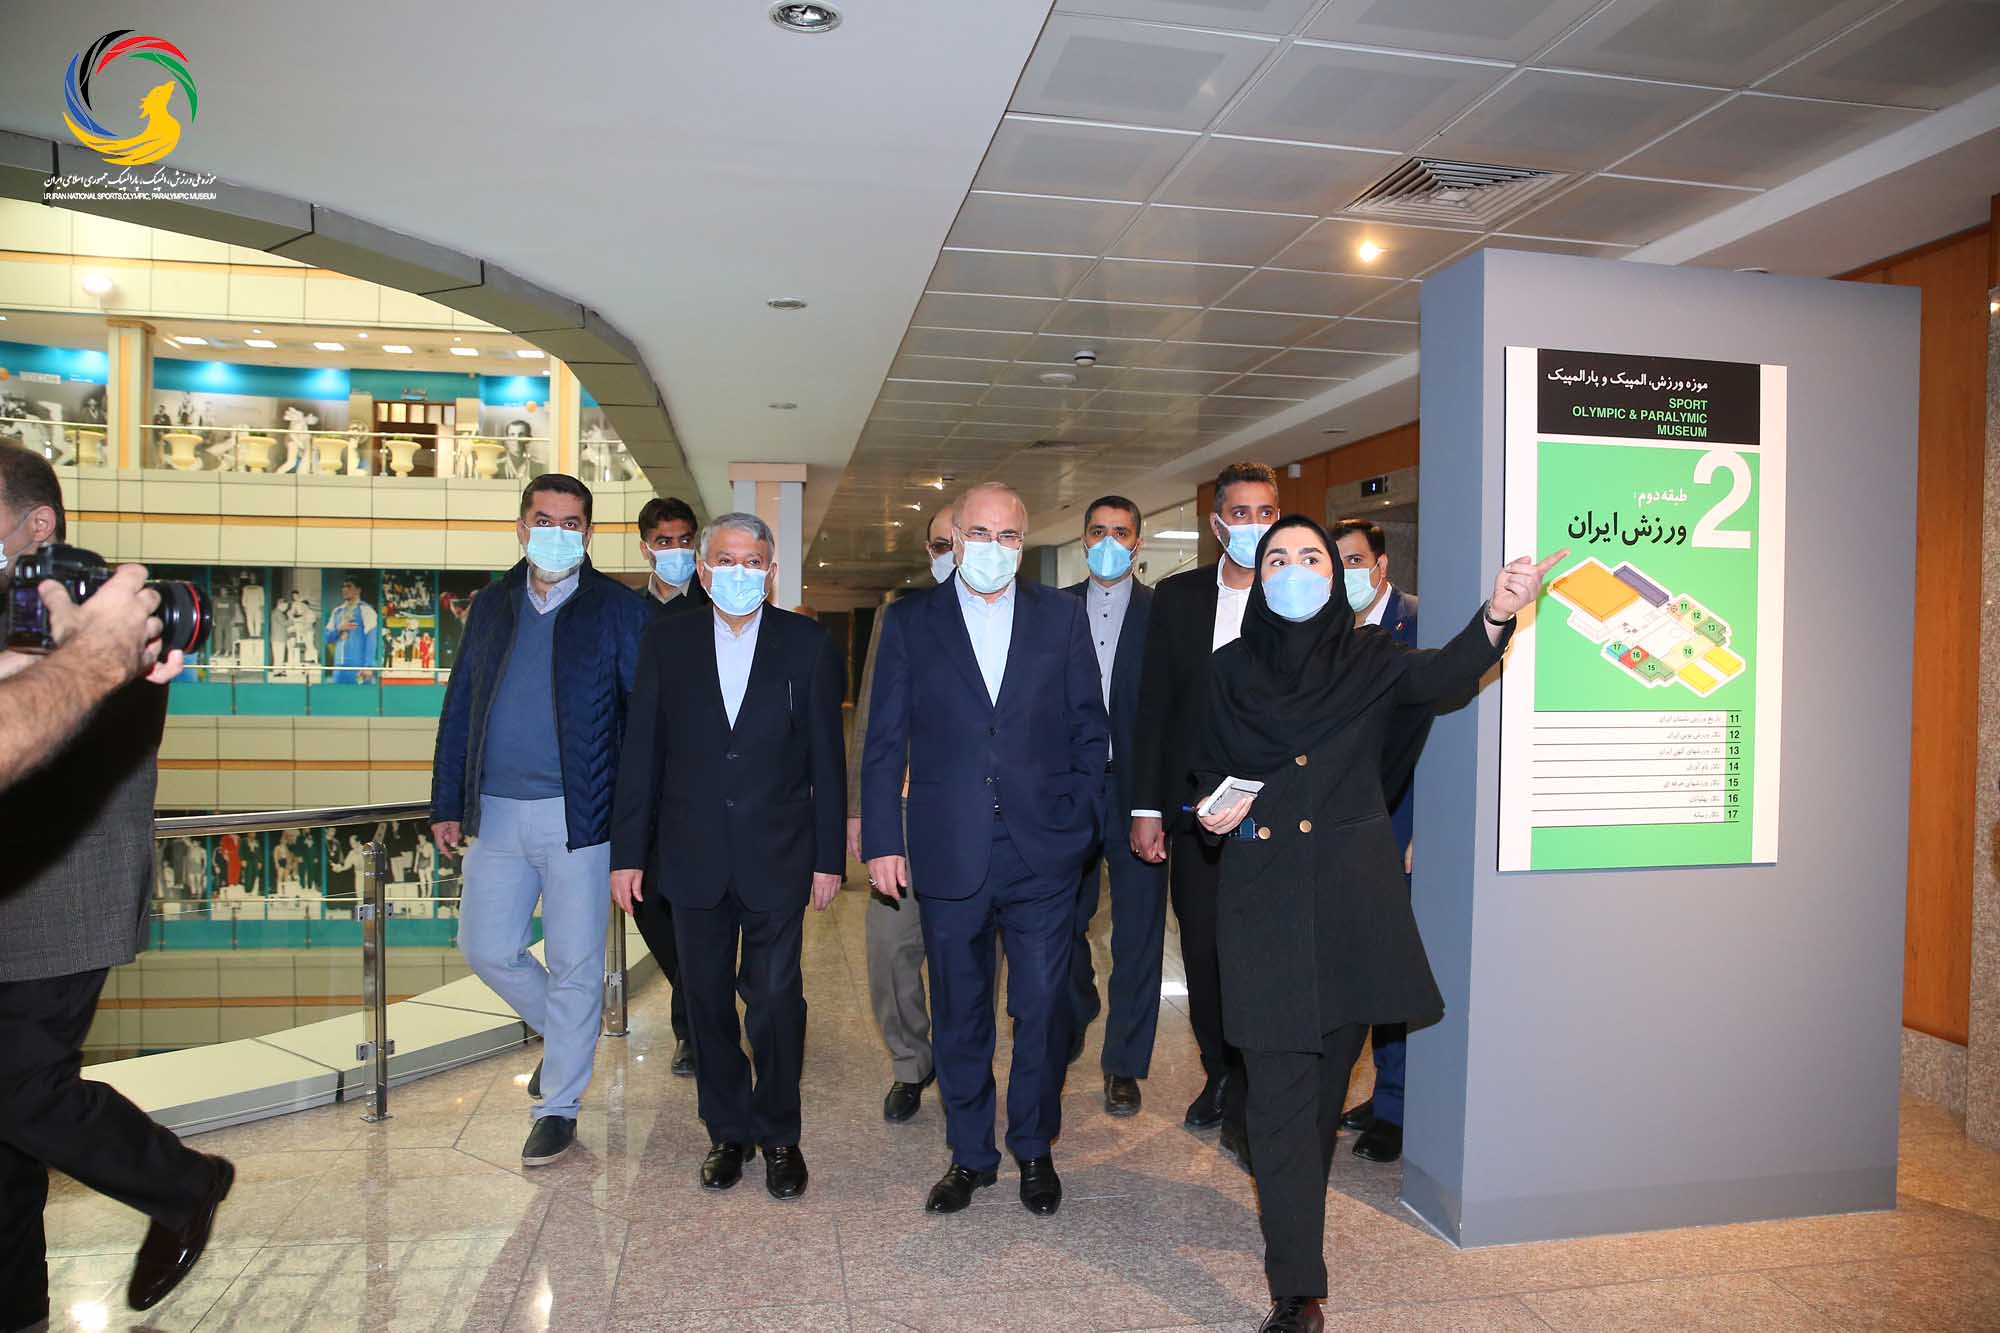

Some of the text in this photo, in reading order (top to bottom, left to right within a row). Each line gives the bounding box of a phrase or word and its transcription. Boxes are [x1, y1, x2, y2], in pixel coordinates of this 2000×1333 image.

[1547, 368, 1599, 388] پارالمپیک
[1601, 375, 1608, 386] و
[1609, 371, 1647, 390] المپیک
[1685, 378, 1709, 393] موزه
[1668, 397, 1708, 411] SPORT
[1572, 405, 1708, 425] OLYMPIC & PARALYMIC
[1657, 424, 1708, 438] MUSEUM
[1661, 487, 1688, 506] طبقه
[1691, 449, 1752, 550] 2
[1568, 510, 1687, 546] ورزش ایران
[1729, 714, 1740, 723] 11
[1729, 730, 1740, 739] 12
[1729, 746, 1740, 755] 13
[1729, 762, 1739, 771] 14
[1728, 778, 1739, 787] 15
[1728, 794, 1739, 803] 16
[1728, 810, 1738, 819] 17
